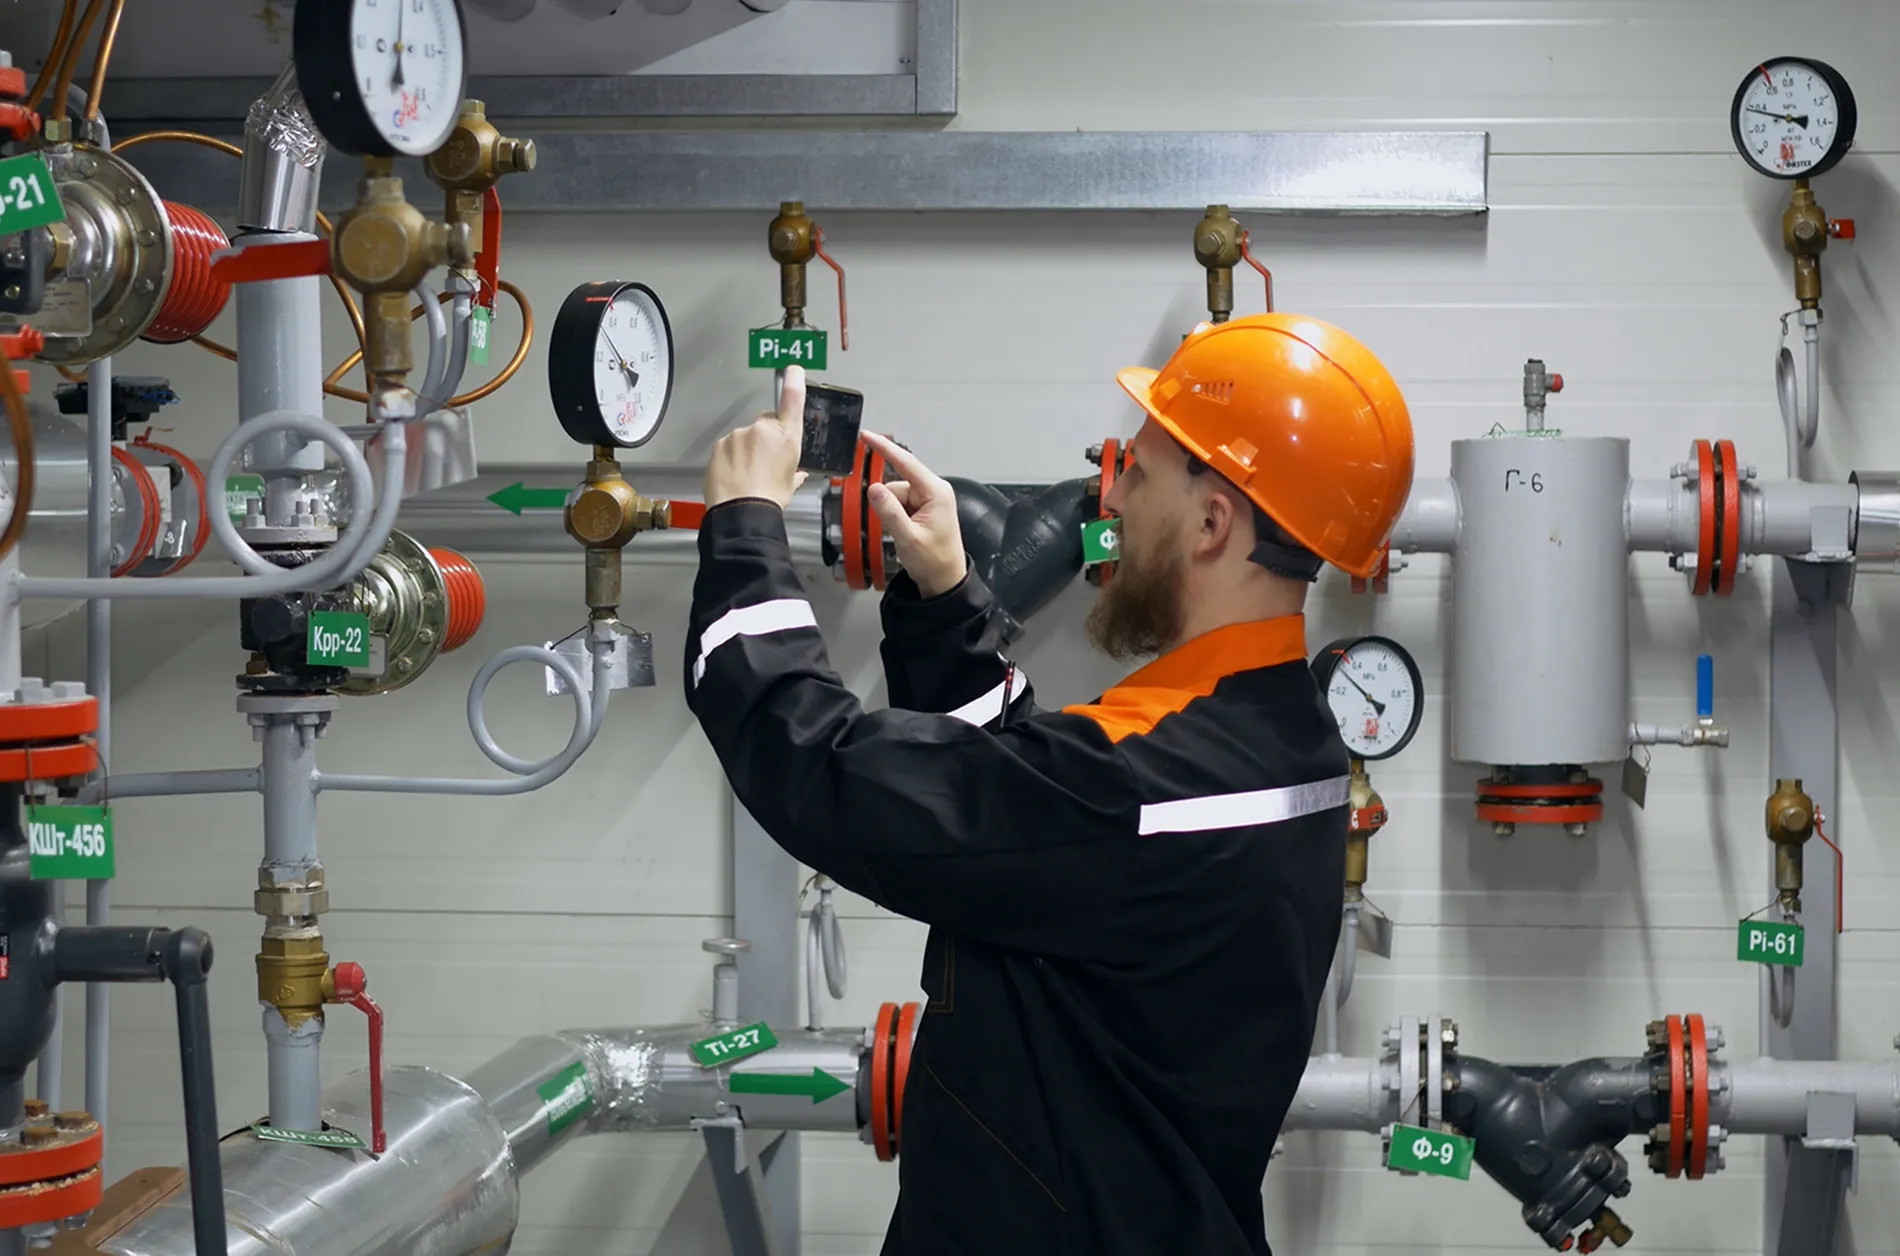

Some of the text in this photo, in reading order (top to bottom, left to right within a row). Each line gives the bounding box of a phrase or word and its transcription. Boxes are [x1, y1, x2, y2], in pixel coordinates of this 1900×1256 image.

[1755, 103, 1767, 111] 04
[760, 338, 814, 360] Pi-41
[313, 625, 362, 657] Крр-22
[28, 822, 105, 857] КШт-456
[1749, 930, 1795, 955] Pi-61
[704, 1029, 760, 1056] Ti-27
[1412, 1136, 1454, 1165] Ф-9
